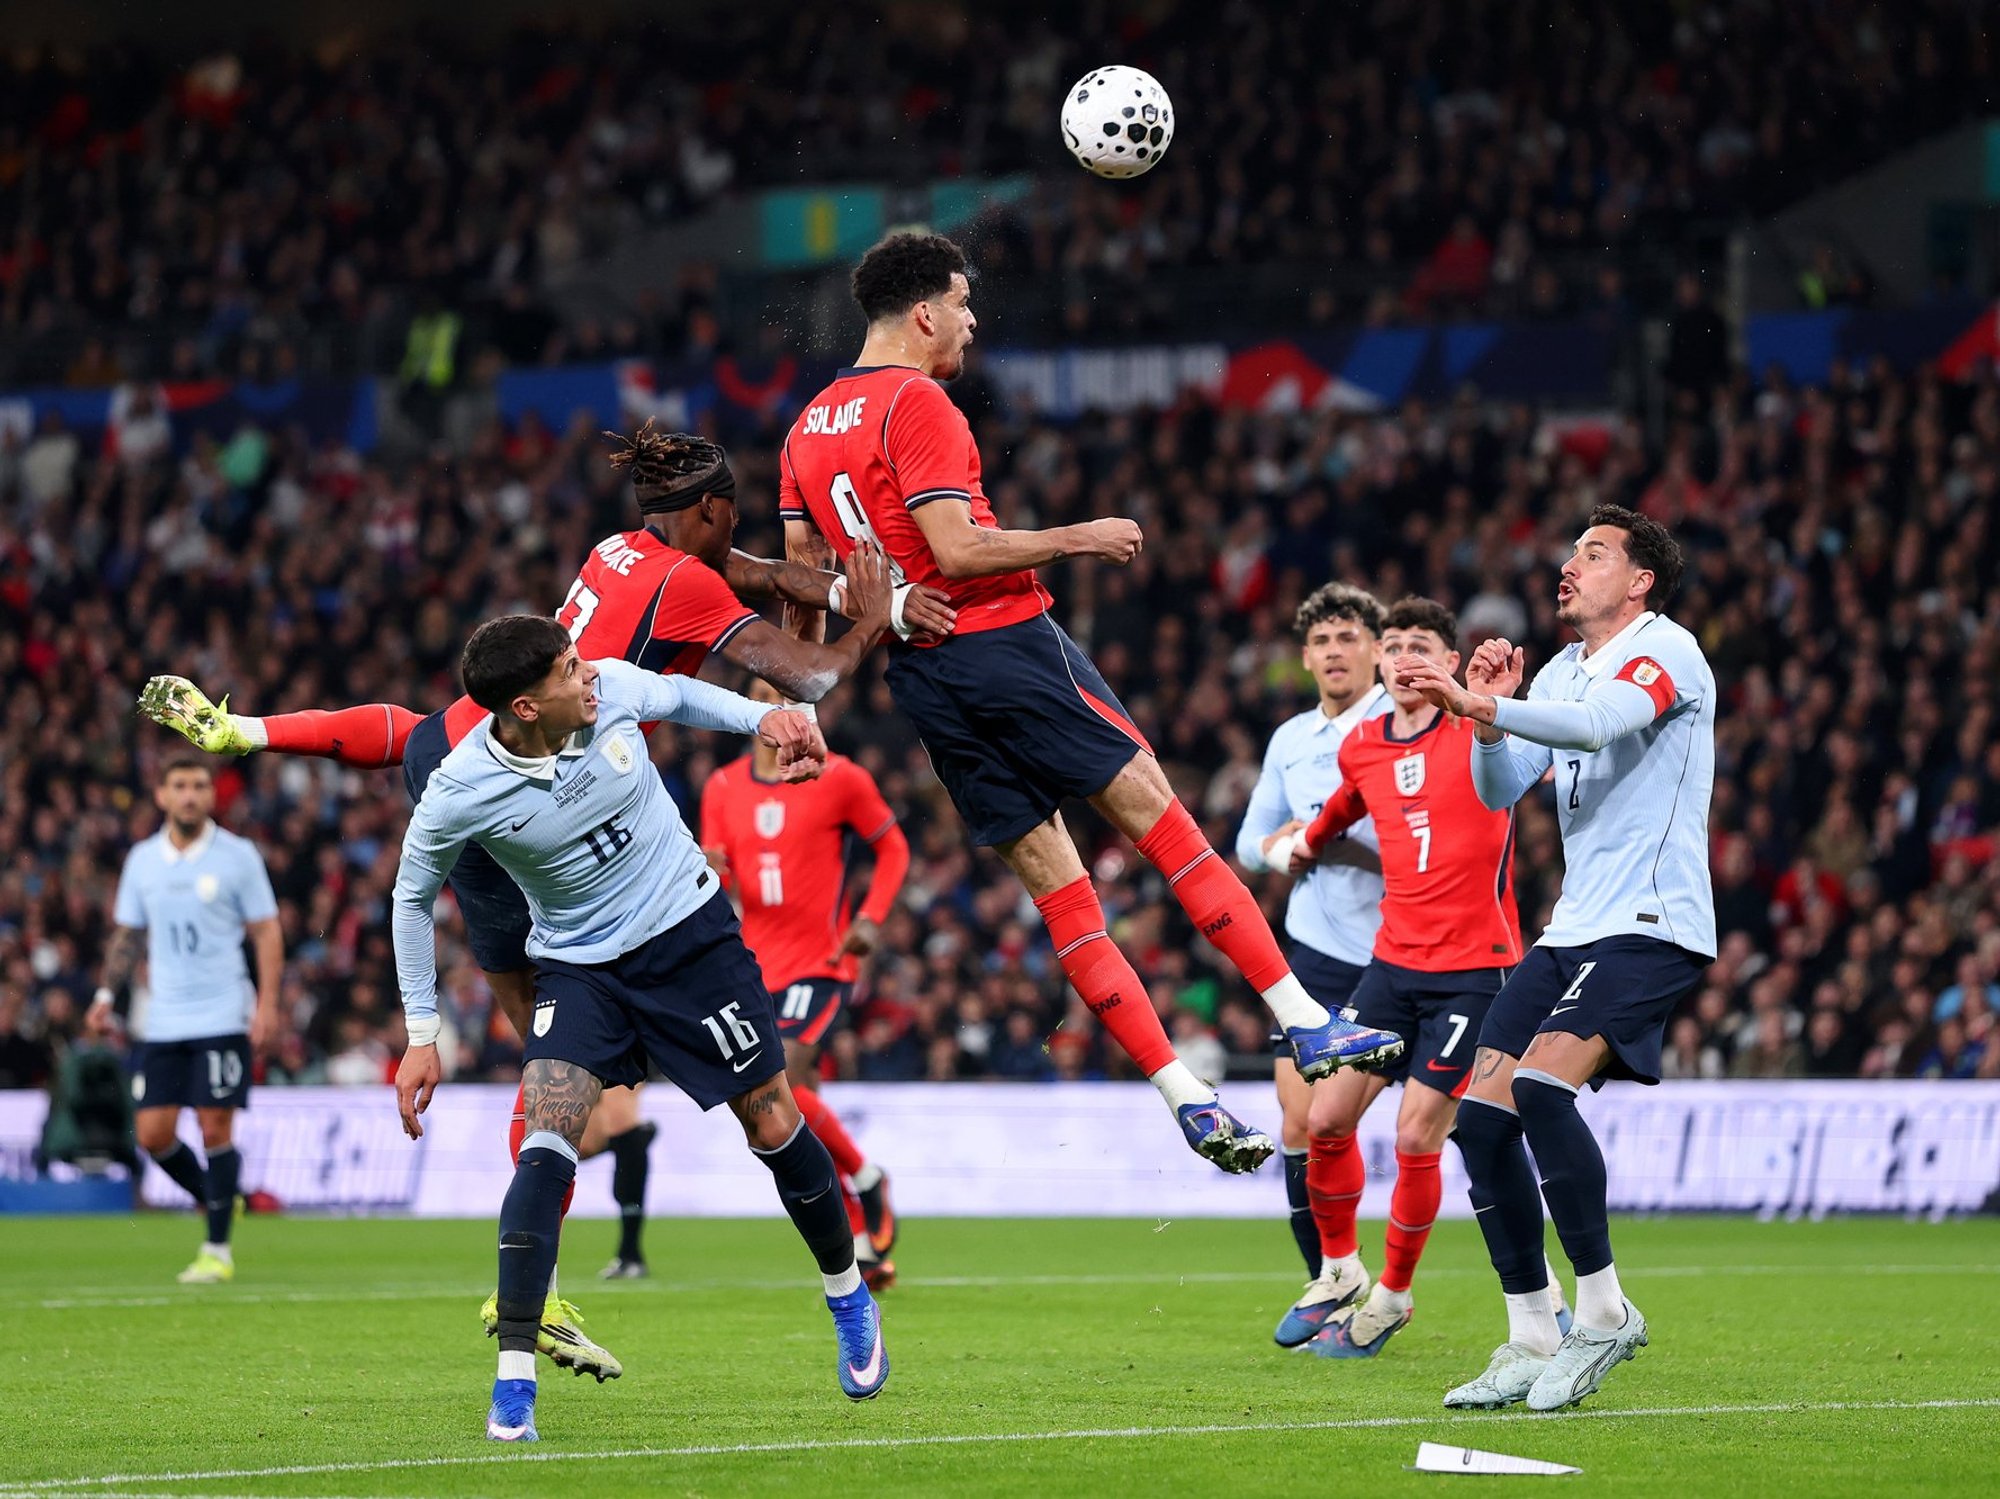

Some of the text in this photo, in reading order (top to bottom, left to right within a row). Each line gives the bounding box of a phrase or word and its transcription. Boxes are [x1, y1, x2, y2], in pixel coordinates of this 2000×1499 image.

[1567, 759, 1581, 810] 2
[580, 813, 634, 865] 16
[1411, 826, 1432, 874] 7
[759, 867, 784, 907] 11
[1202, 911, 1233, 937] ENG
[1560, 961, 1598, 1001] 2
[782, 984, 814, 1020] 11
[1091, 992, 1122, 1016] ENG
[701, 1000, 761, 1061] 16
[1440, 1014, 1469, 1058] 7
[207, 1050, 243, 1087] 10
